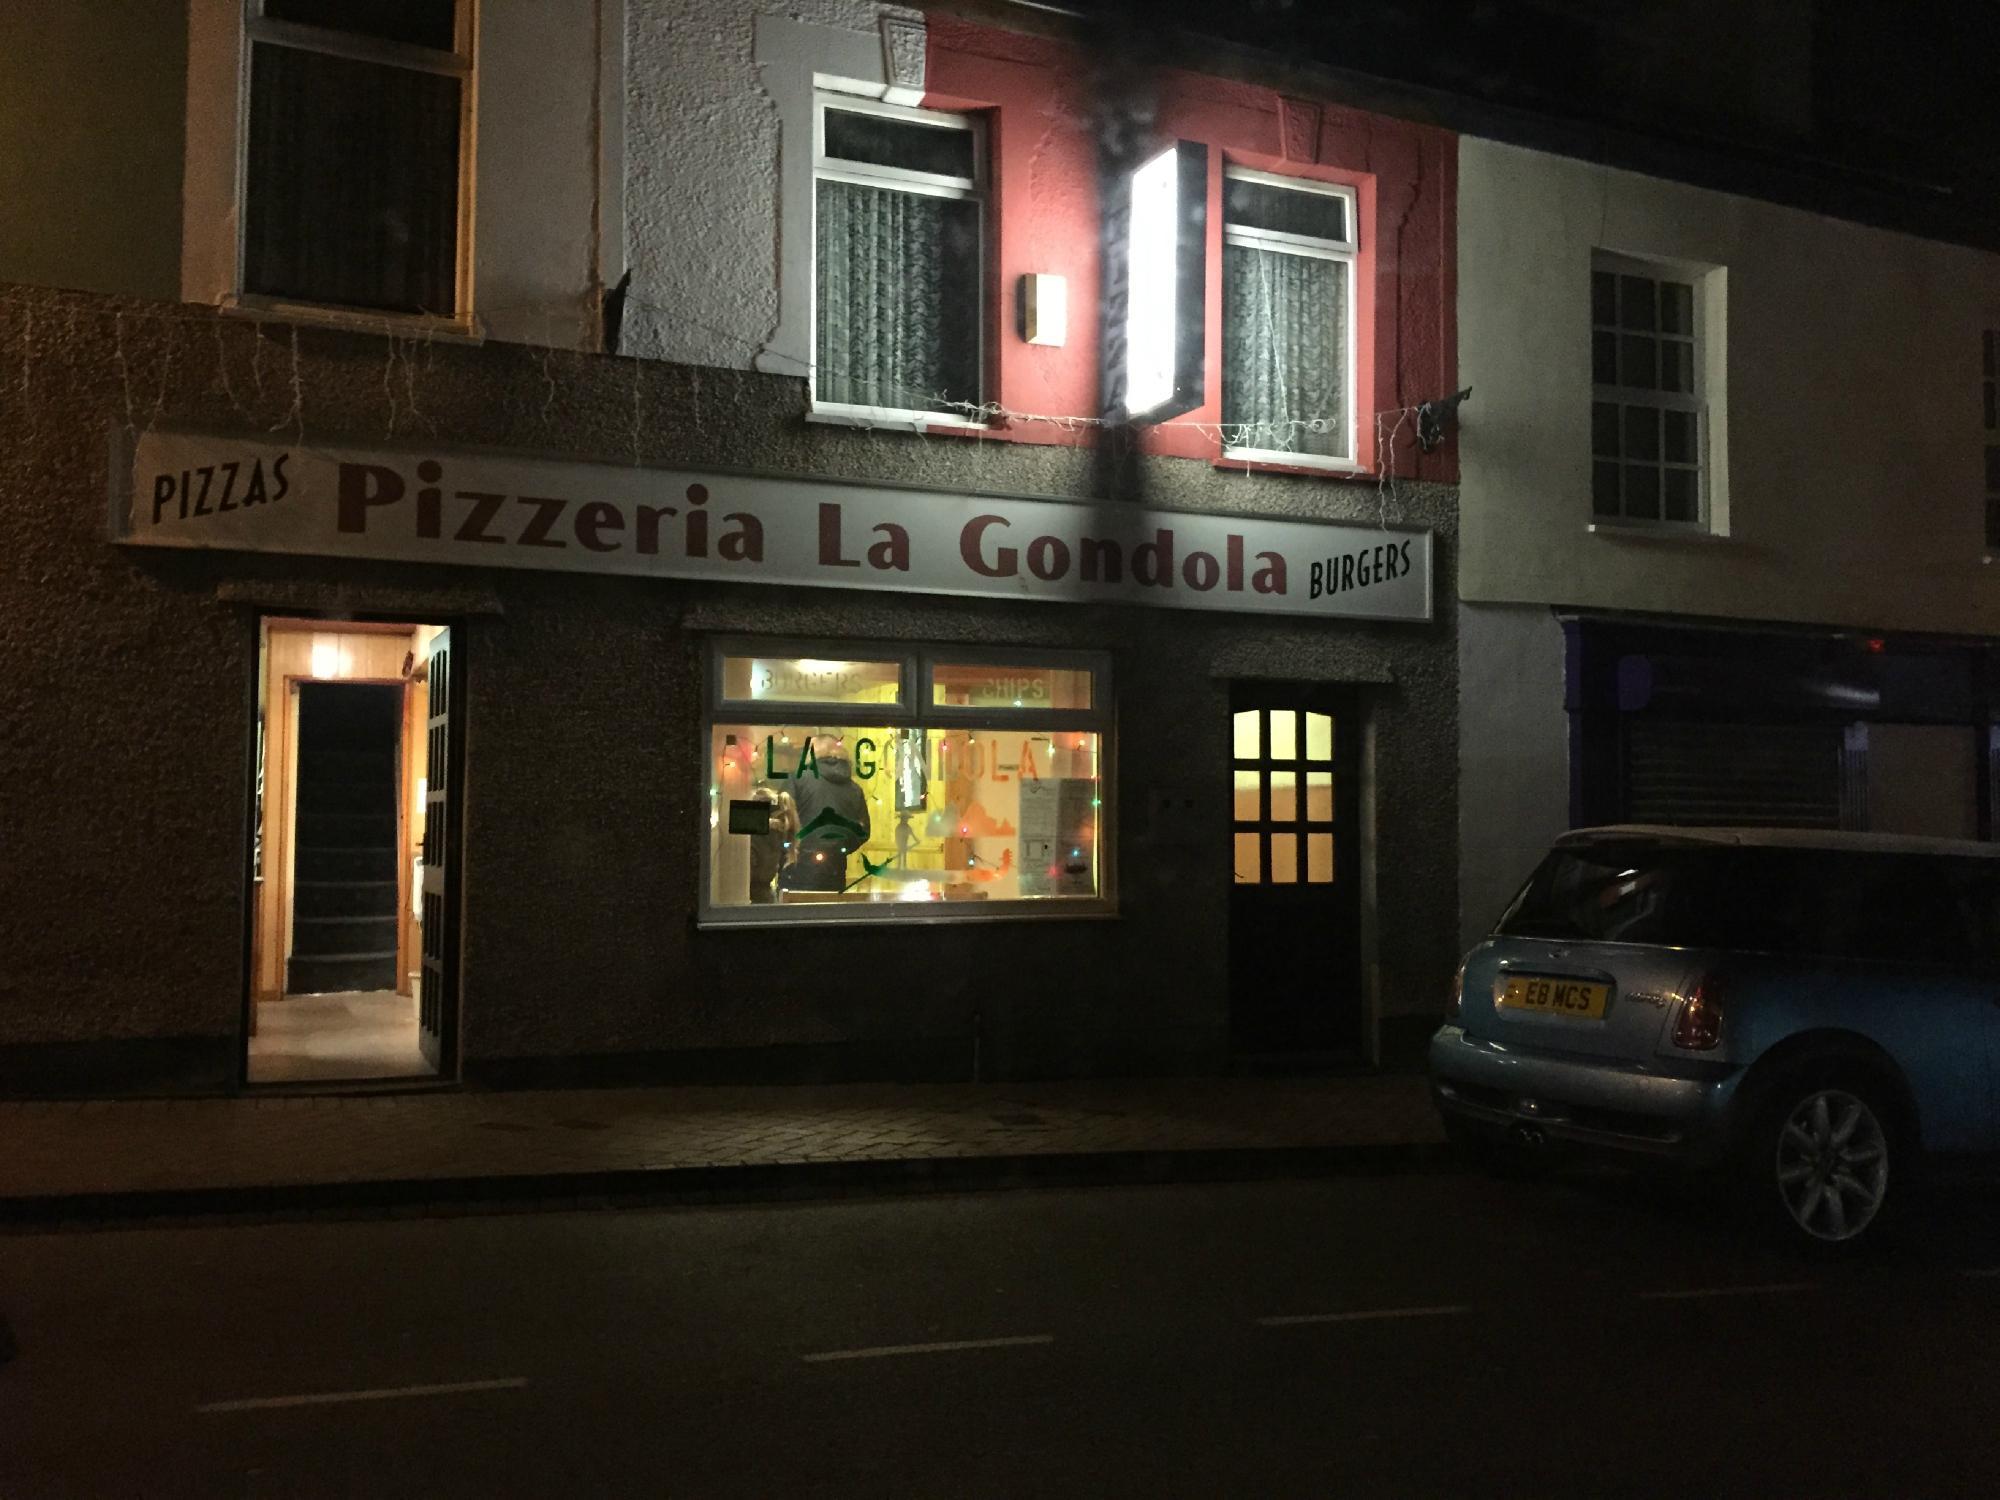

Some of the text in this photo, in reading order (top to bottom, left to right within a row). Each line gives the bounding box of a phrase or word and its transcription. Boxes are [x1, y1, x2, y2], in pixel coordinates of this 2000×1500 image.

[152, 453, 290, 525] PIZZAS
[337, 459, 1289, 596] Pizzeria La Gondola
[1308, 539, 1412, 600] BURGERS
[765, 734, 820, 781] LA
[1552, 984, 1593, 1012] MCS
